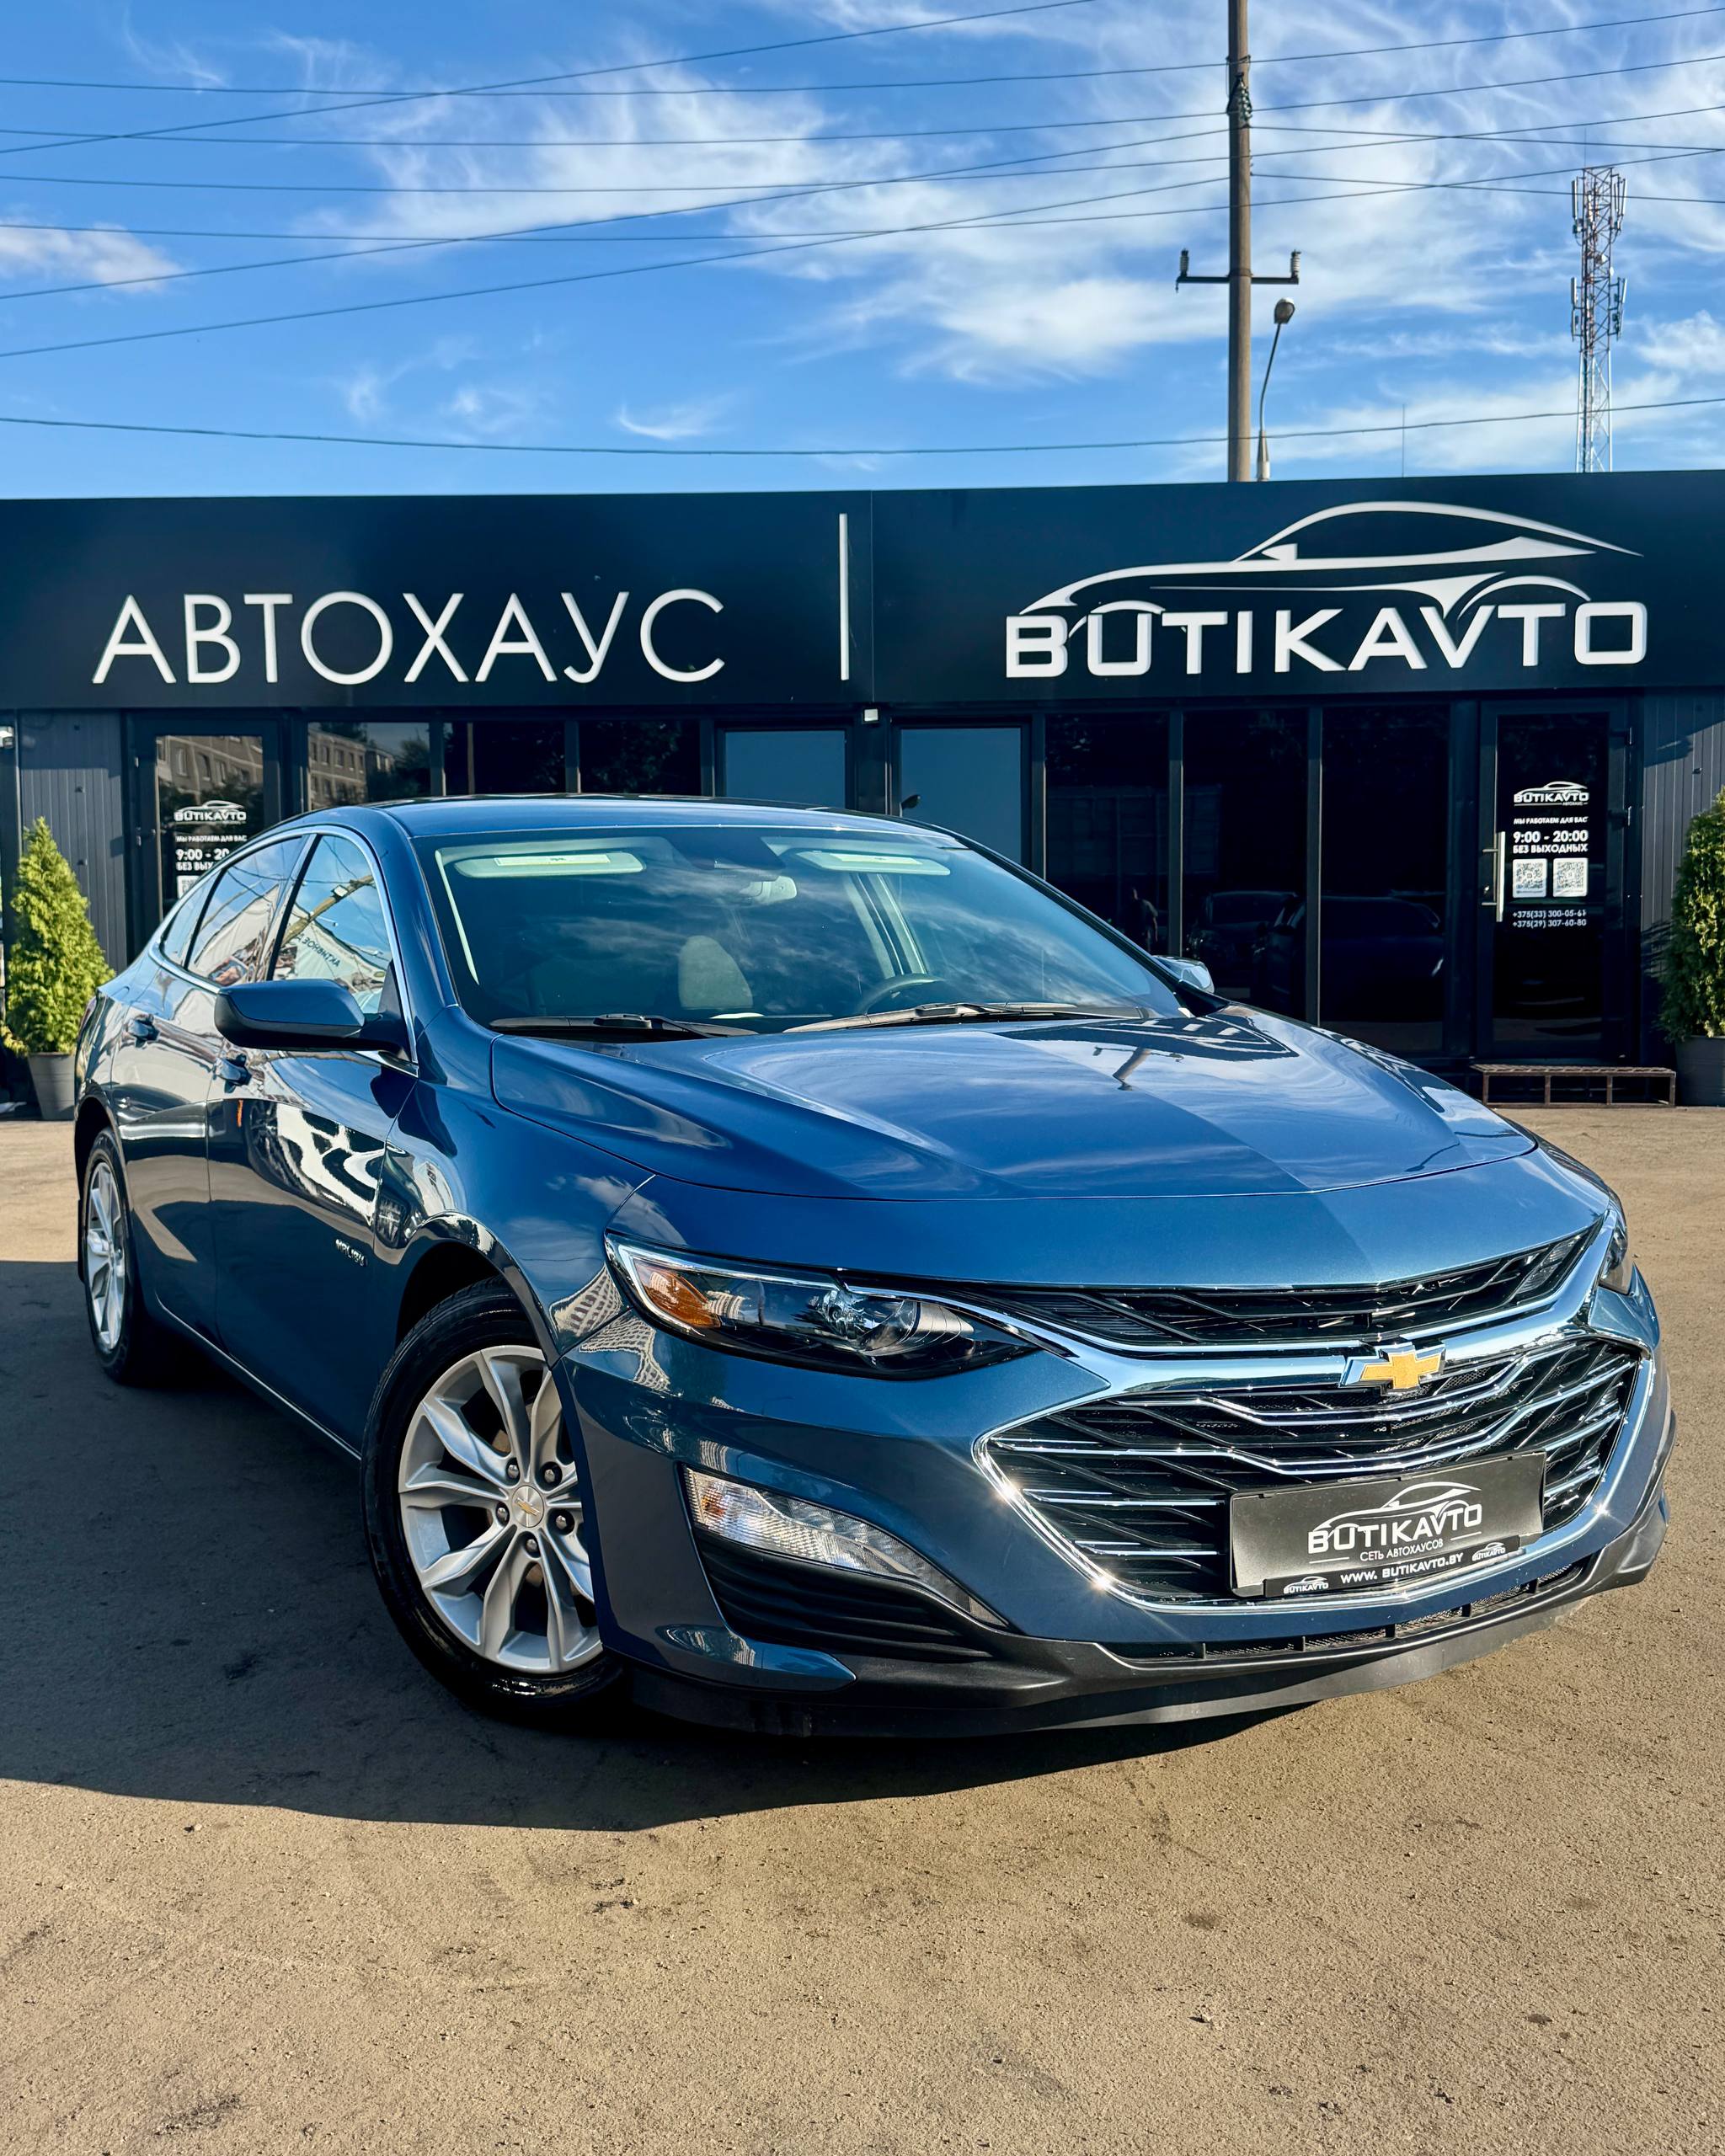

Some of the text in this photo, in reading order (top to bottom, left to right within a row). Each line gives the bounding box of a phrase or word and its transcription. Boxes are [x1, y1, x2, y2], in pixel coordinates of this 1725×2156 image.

[93, 588, 725, 685] АВТОХАУС
[1006, 600, 1648, 679] BUTIKAVTO
[1514, 792, 1589, 803] BUTIKAVTO
[174, 811, 247, 821] BUTIKAVTO
[1513, 831, 1541, 843] 9:00
[1553, 830, 1589, 842] 20:00
[175, 848, 203, 861] 9:00
[1513, 843, 1589, 854] БЕЗ ВЫХОДНЫХ
[176, 862, 193, 871] БЕЗ
[1308, 1504, 1482, 1554] BUTIKAVTO
[1359, 1539, 1443, 1561] СЕТЬ АВТОХАУСОВ
[1472, 1547, 1506, 1561] BUTIKAVTO
[1382, 1553, 1464, 1578] BUTIKAVTO.BY
[1284, 1582, 1329, 1594] BUTIKAVTO
